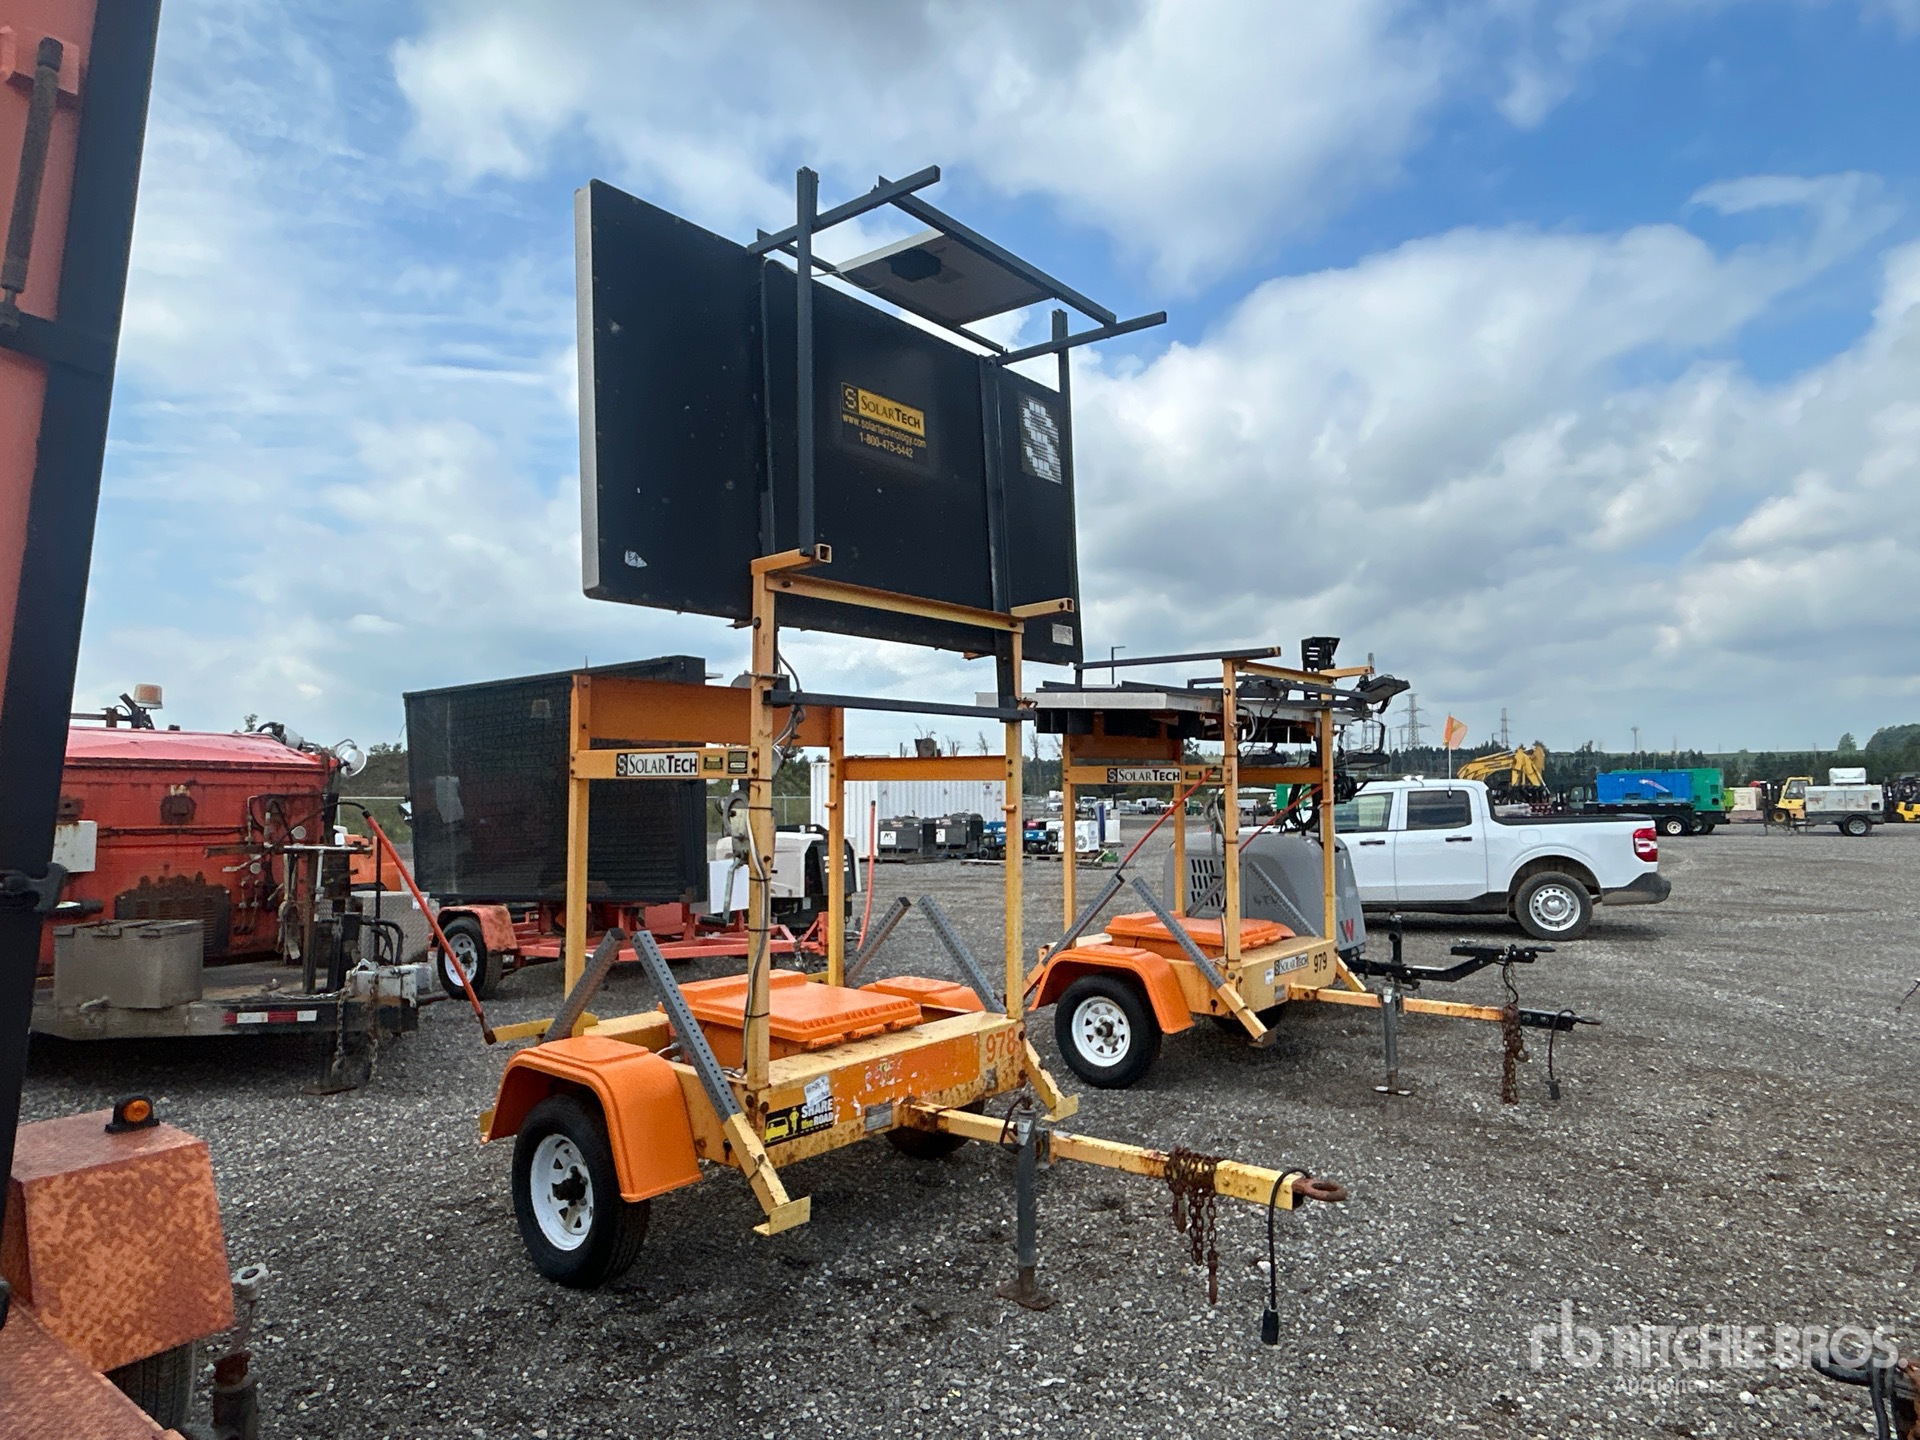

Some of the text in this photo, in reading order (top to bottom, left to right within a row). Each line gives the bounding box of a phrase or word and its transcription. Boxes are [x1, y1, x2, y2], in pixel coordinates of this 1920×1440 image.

[628, 754, 698, 775] SOLARTECH
[1118, 769, 1181, 783] SOLARTECH
[1313, 951, 1328, 974] 979
[986, 1026, 1016, 1064] 978
[813, 1111, 834, 1126] ROAD
